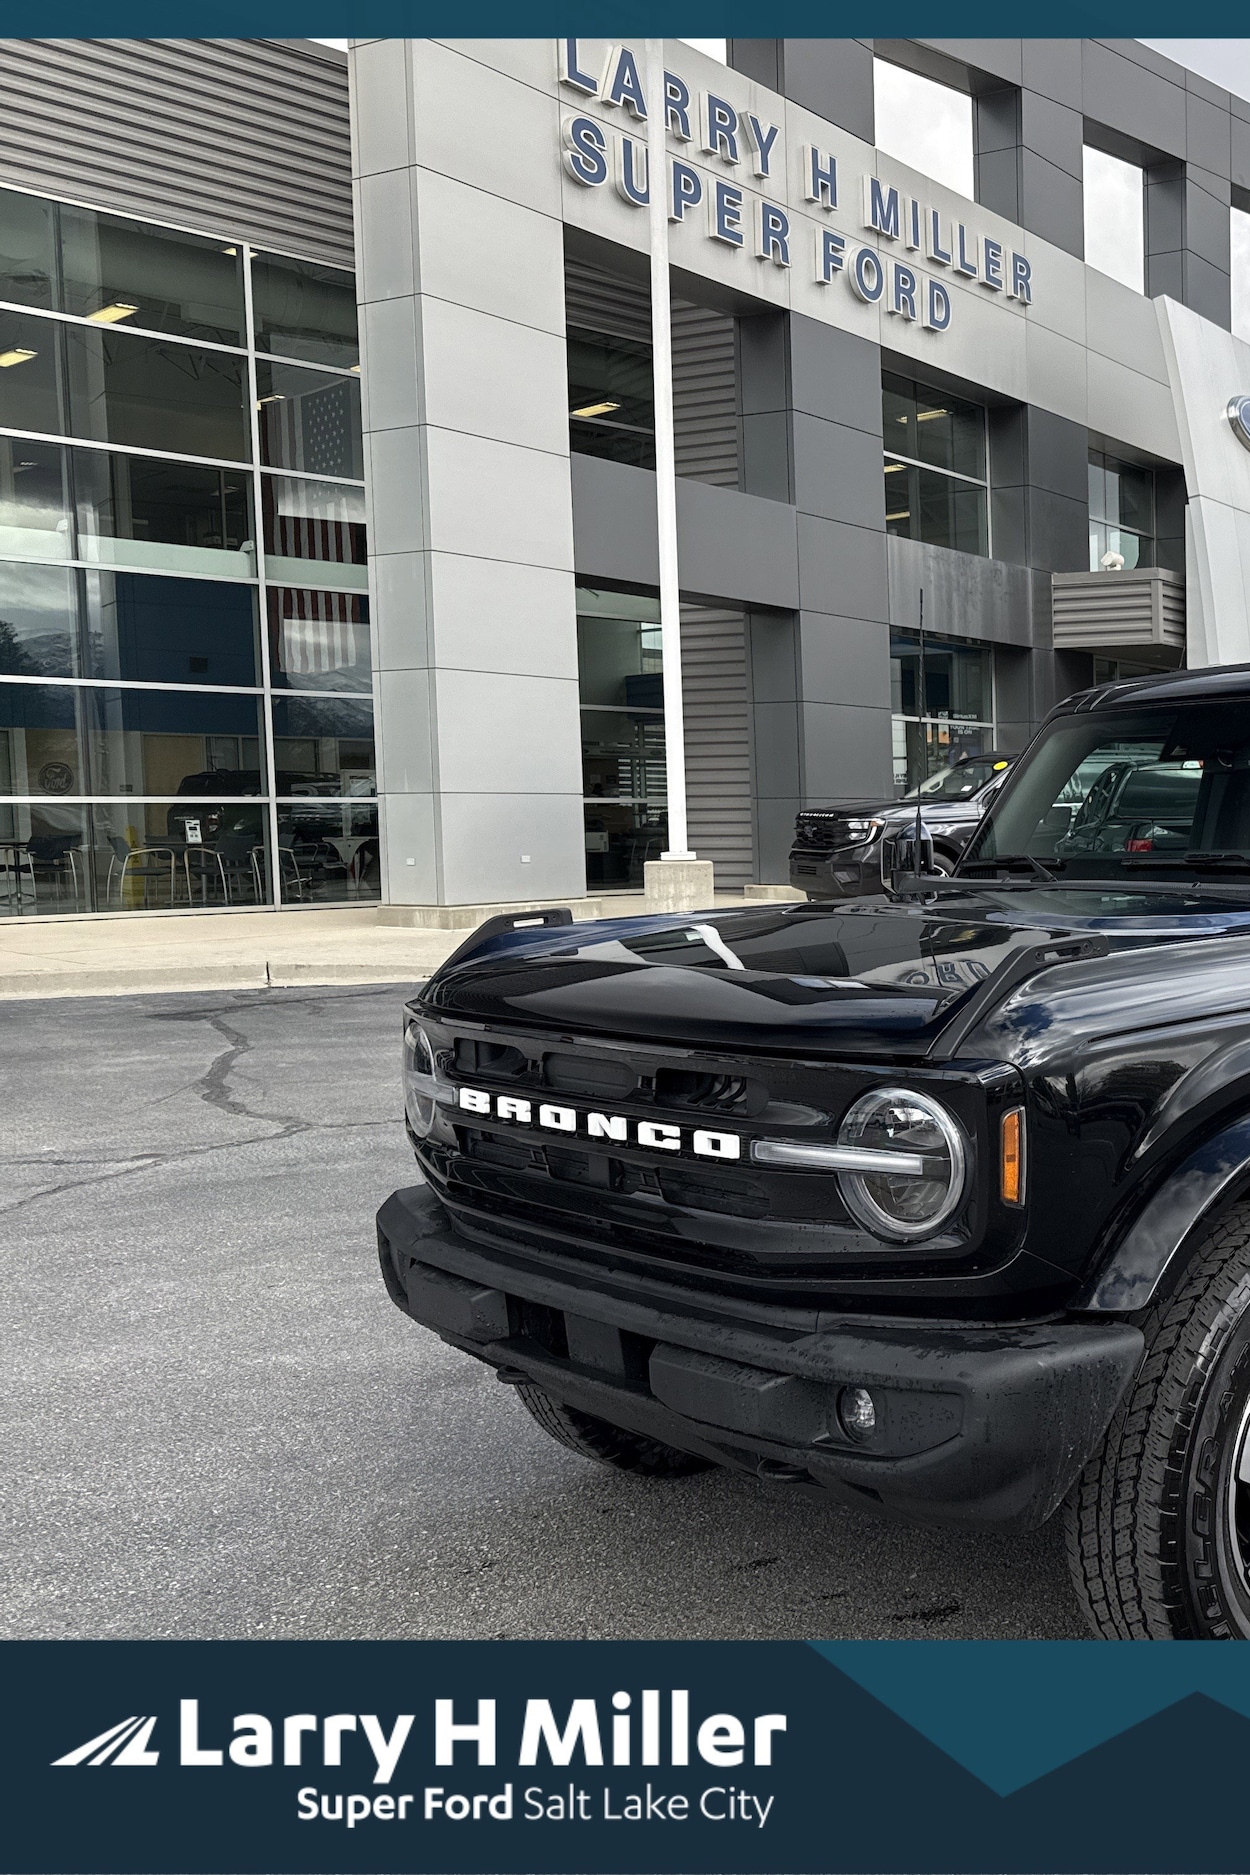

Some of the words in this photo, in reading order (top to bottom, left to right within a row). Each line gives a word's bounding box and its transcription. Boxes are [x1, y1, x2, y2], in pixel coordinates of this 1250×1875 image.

[559, 38, 781, 179] LARRY
[804, 144, 839, 211] H
[863, 173, 1033, 305] MILLER
[562, 114, 791, 268] SUPER
[815, 226, 952, 333] FORD
[459, 1087, 741, 1160] BRONCO
